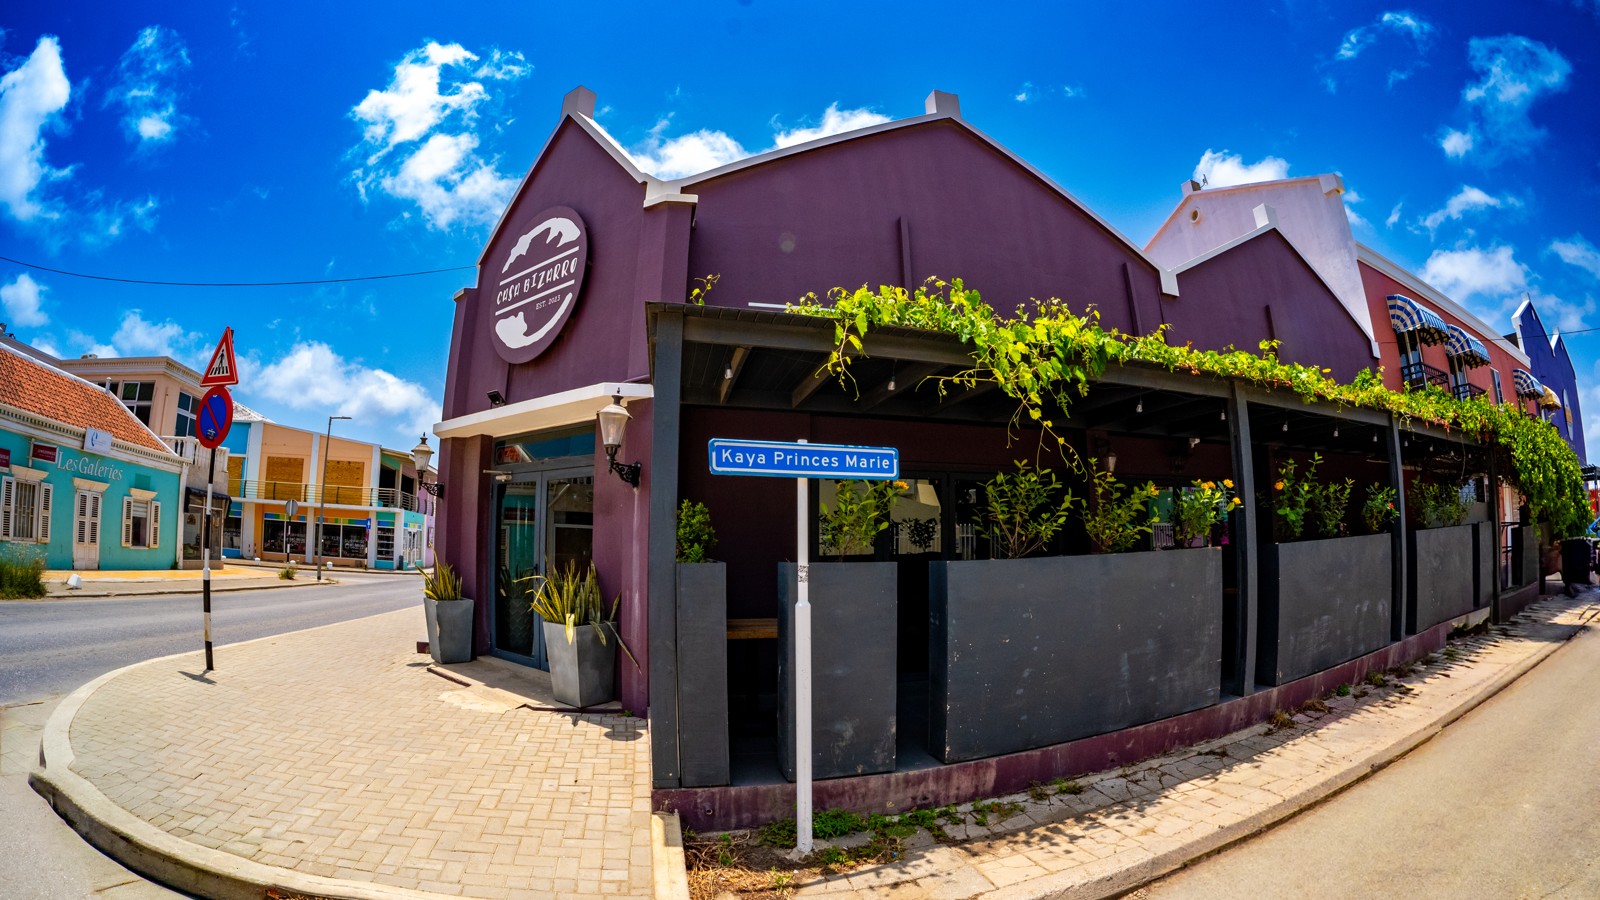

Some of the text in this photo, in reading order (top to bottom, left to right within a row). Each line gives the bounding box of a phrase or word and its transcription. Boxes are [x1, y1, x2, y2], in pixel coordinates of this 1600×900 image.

[496, 257, 578, 305] CASA BIZARRO
[535, 294, 561, 310] EST. 2023
[57, 451, 77, 471] Les
[78, 456, 124, 480] Galeries
[721, 449, 890, 469] Kaya Princes Marie
